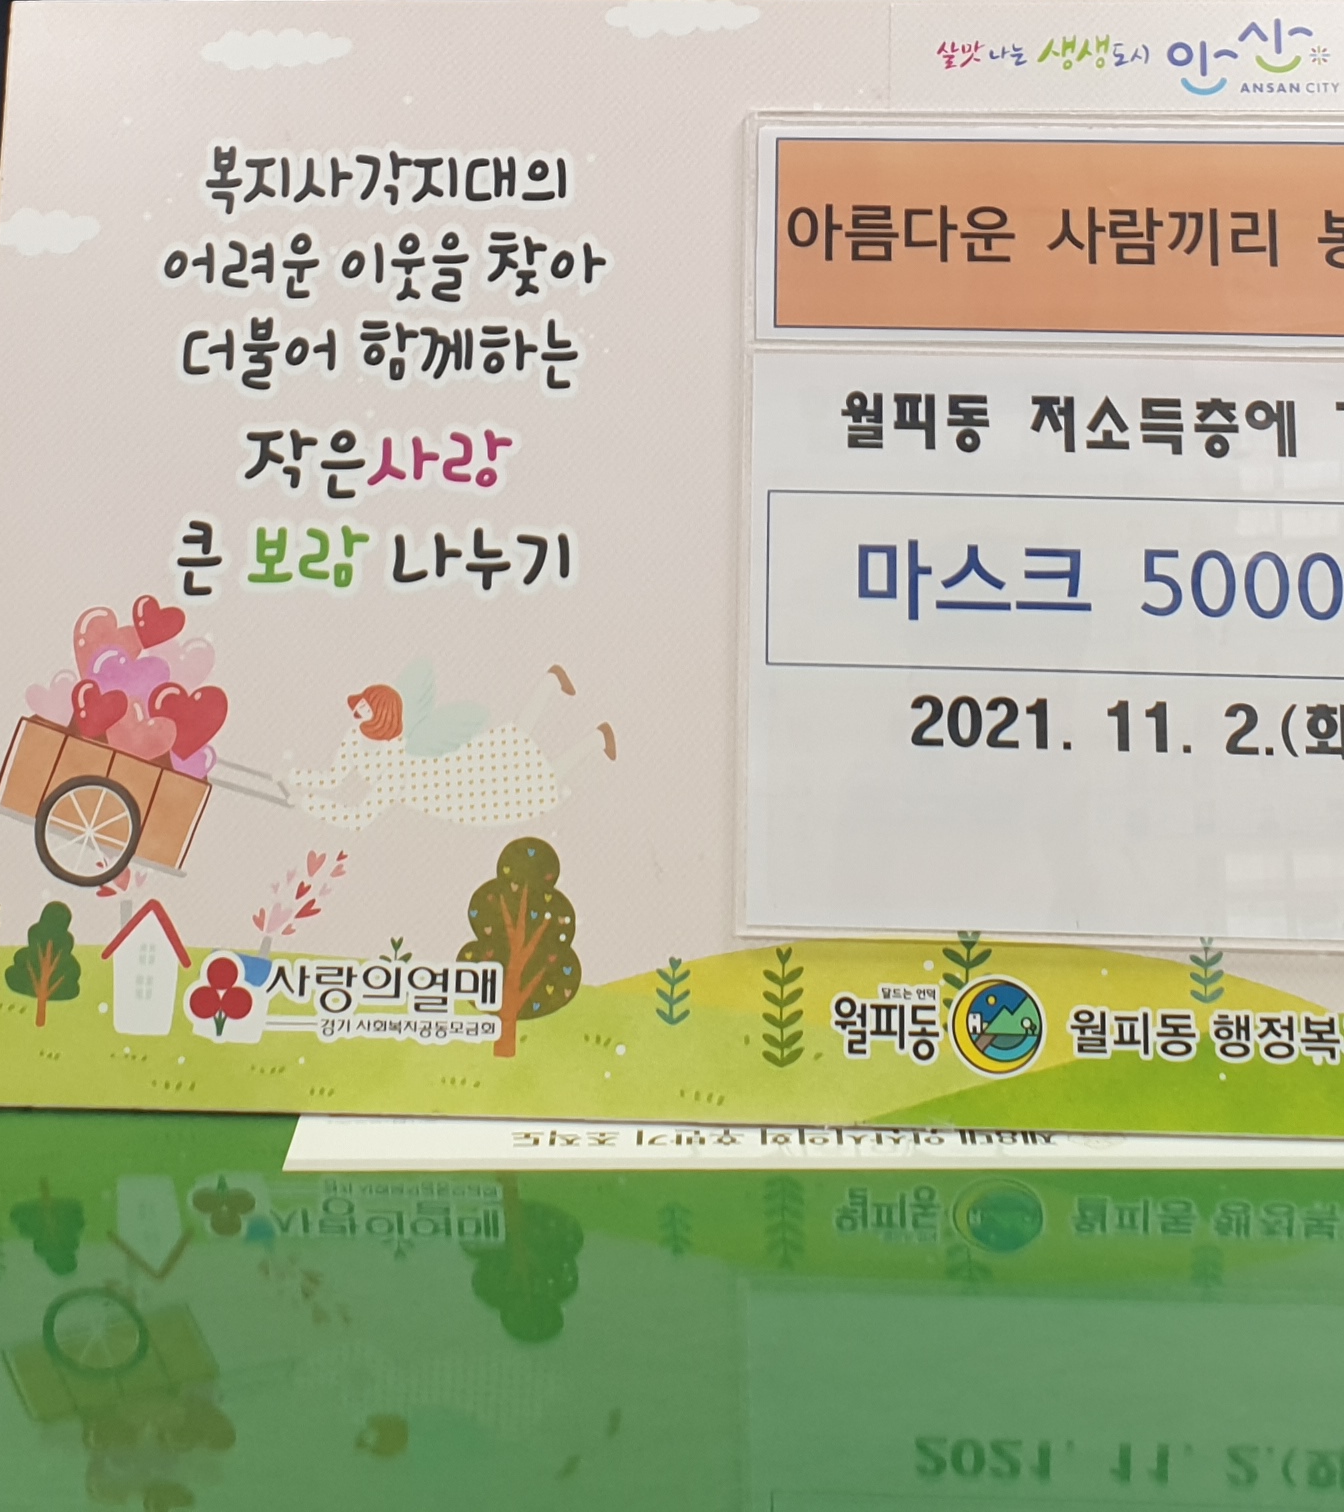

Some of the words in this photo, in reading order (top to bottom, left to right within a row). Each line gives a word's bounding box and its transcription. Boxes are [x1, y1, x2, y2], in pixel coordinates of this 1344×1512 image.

[936, 40, 986, 70] 살맛
[988, 43, 1028, 66] 나는
[1239, 81, 1301, 94] ANSAN
[1304, 80, 1340, 94] CITY
[204, 144, 568, 214] 복지사각지대의
[162, 232, 321, 300] 어려운
[340, 230, 471, 303] 이웃을
[486, 230, 607, 298] 찾아
[787, 202, 1017, 264] 아름다운
[1046, 202, 1280, 269] 사람끼리
[181, 316, 338, 391] 더불어
[358, 317, 581, 391] 함께하는
[840, 389, 991, 454] 월피동
[1029, 393, 1298, 461] 저소득층에
[176, 519, 224, 596] 큰
[247, 525, 370, 588] 보람
[391, 529, 573, 591] 나누기
[855, 538, 1094, 624] 마스크
[909, 694, 1074, 752] 2021.
[1107, 699, 1193, 755] 11.
[266, 964, 499, 1014] 사랑의열매
[319, 1017, 352, 1038] 경기
[355, 1017, 497, 1039] 사회복지공동모금회
[834, 996, 940, 1061] 월피동
[1068, 1010, 1195, 1059] 월피동
[510, 1129, 622, 1148] 조직도
